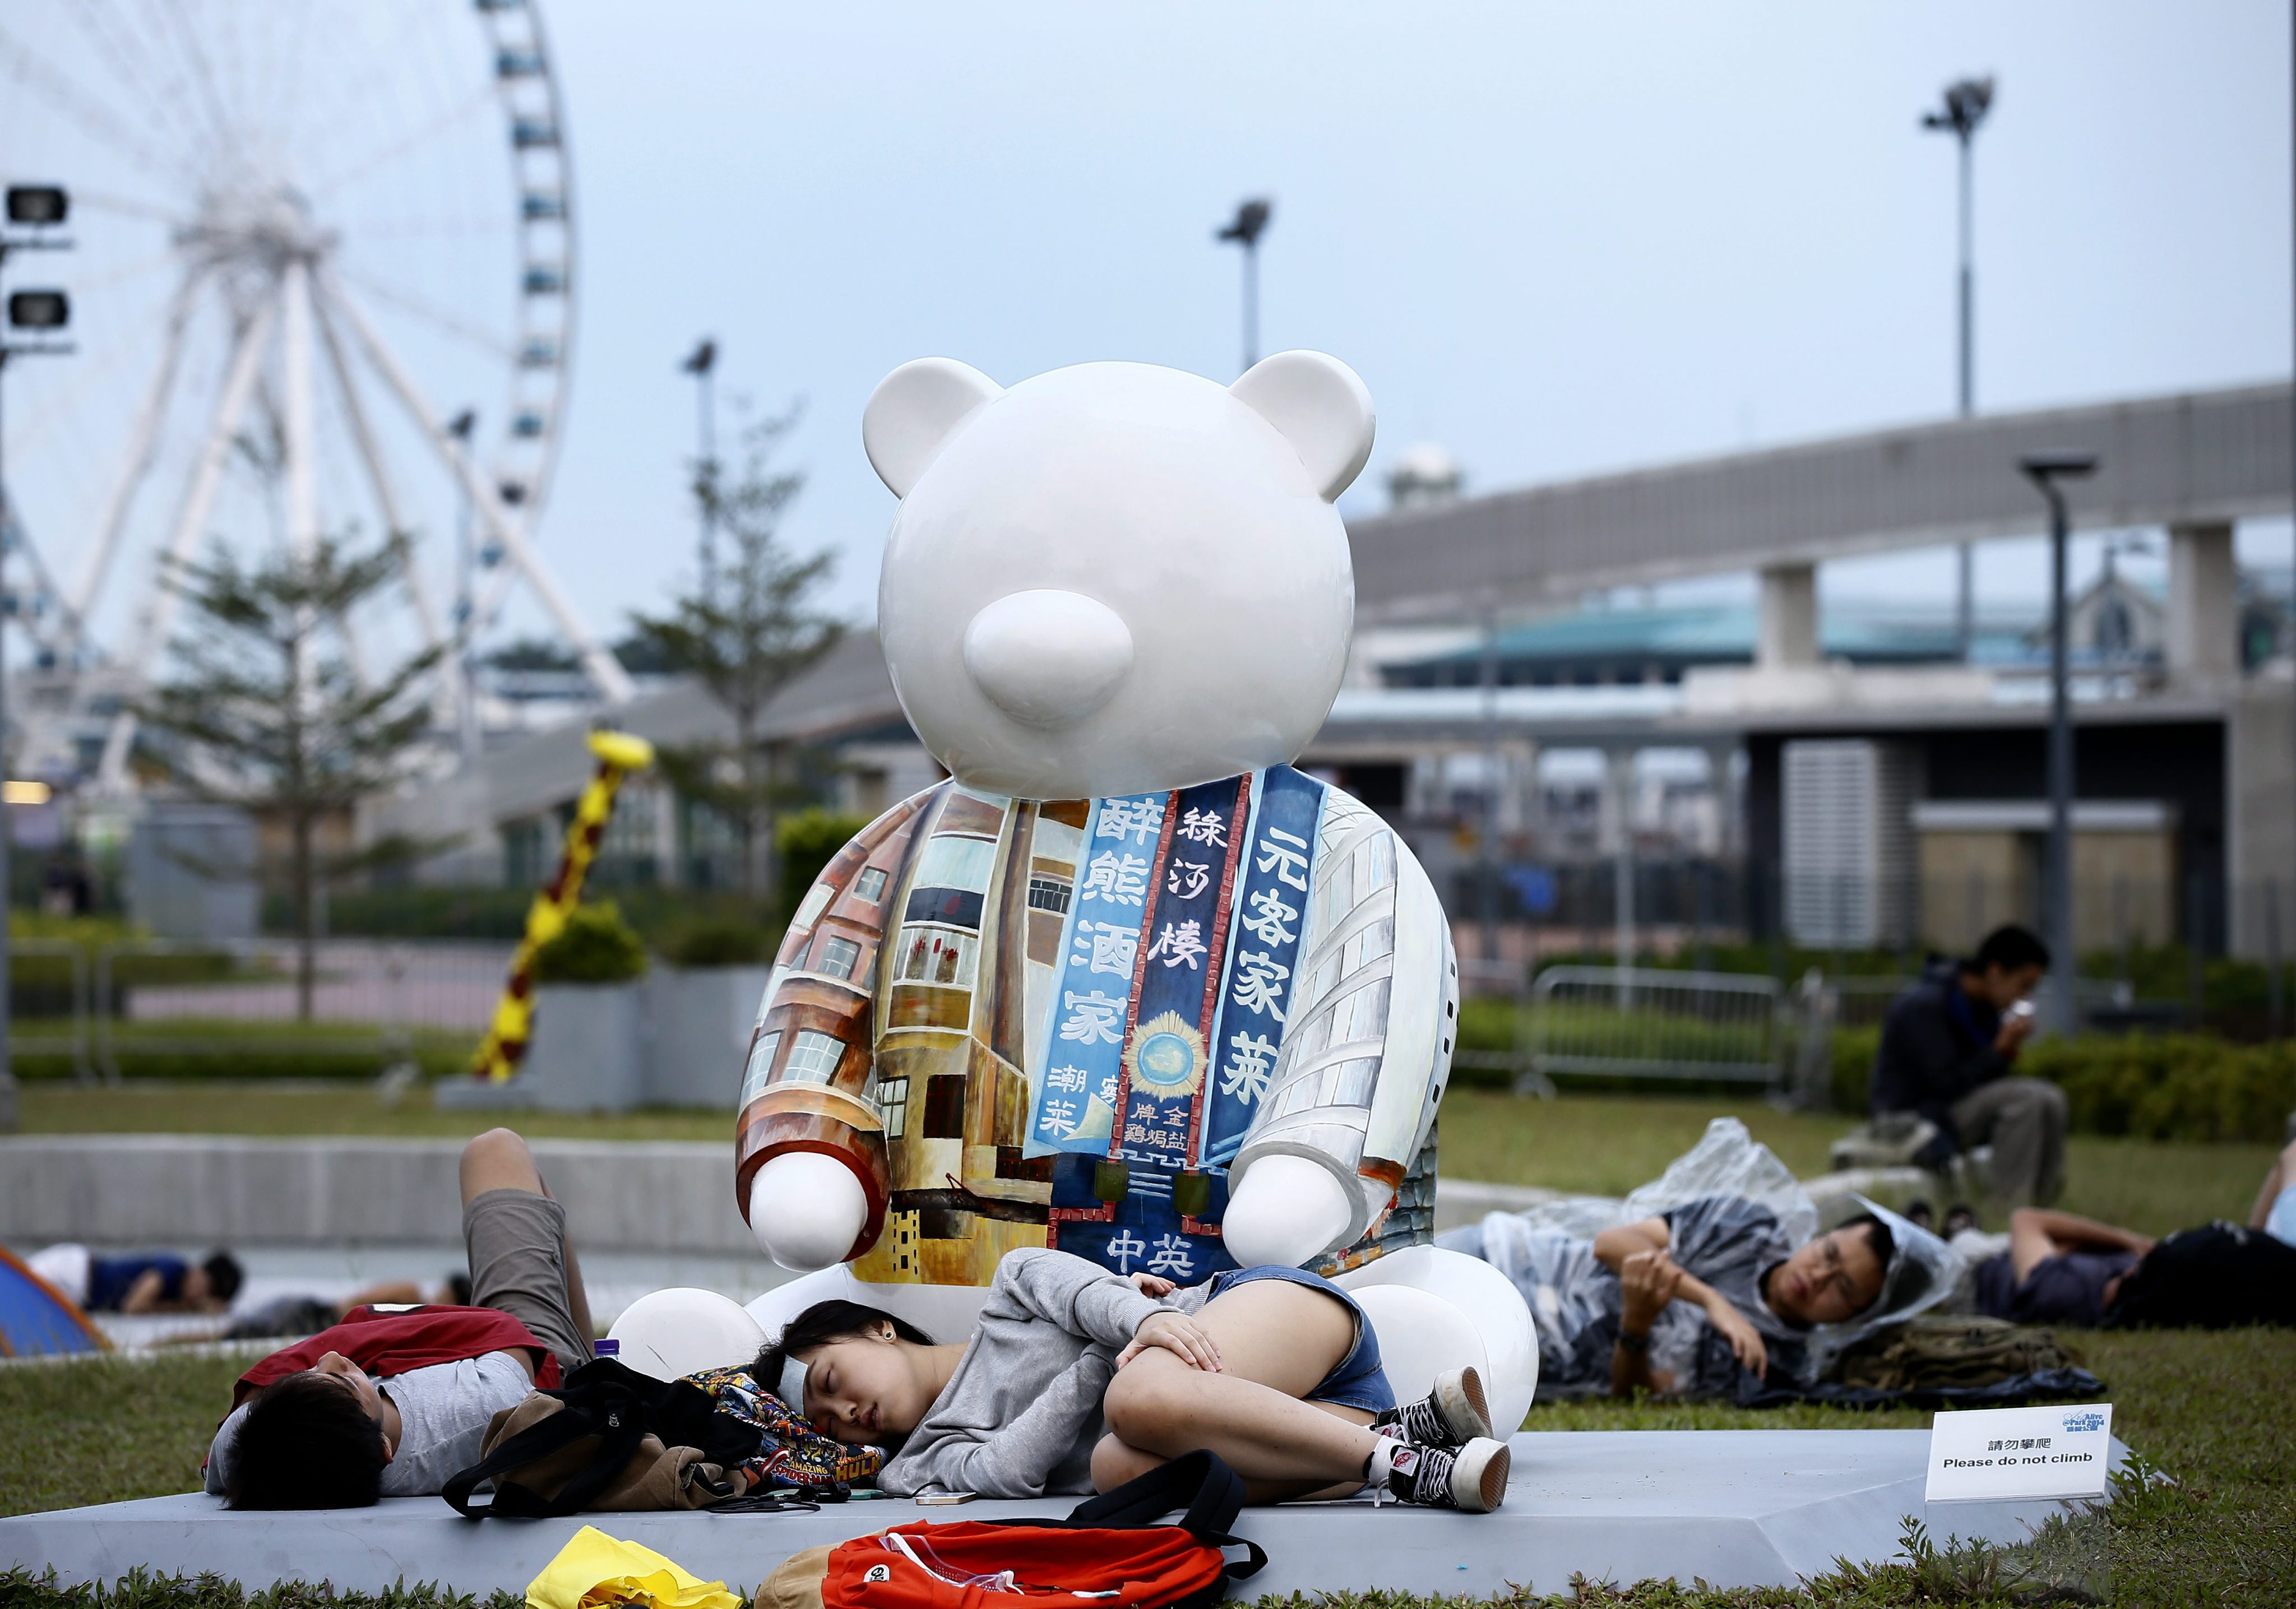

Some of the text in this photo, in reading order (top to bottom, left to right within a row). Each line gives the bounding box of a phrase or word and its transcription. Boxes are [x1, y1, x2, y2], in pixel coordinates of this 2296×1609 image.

[1107, 1229, 1195, 1277] 中英
[1988, 1438, 2052, 1452] 請勿攀爬
[789, 1460, 828, 1474] AMAZING
[1943, 1452, 2093, 1468] Please do not climb
[836, 1455, 882, 1482] HULK
